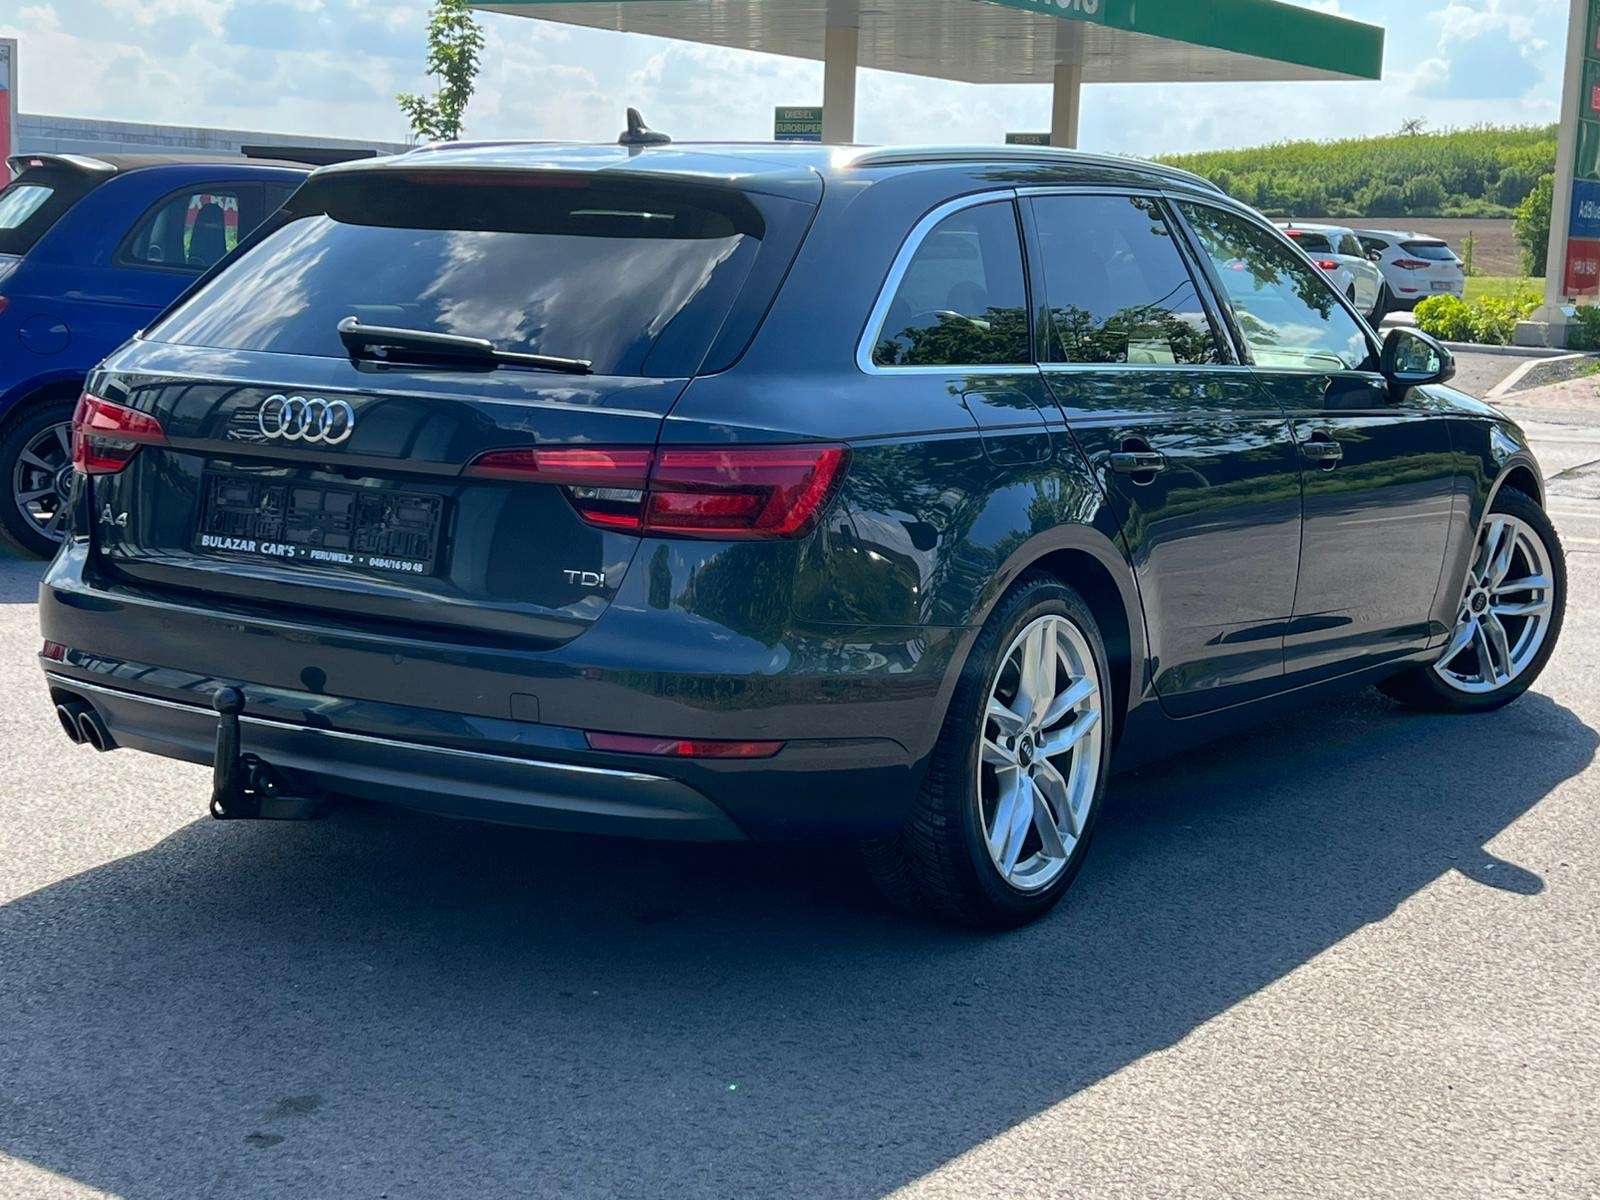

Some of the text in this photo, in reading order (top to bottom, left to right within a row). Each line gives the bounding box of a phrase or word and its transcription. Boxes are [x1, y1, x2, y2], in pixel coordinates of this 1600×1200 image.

[784, 110, 814, 119] DIESEL
[99, 503, 128, 528] A4
[201, 535, 256, 552] BULAZAR
[260, 543, 296, 558] CAR'S
[310, 549, 354, 564] PERUWELZ
[563, 569, 605, 588] TDI
